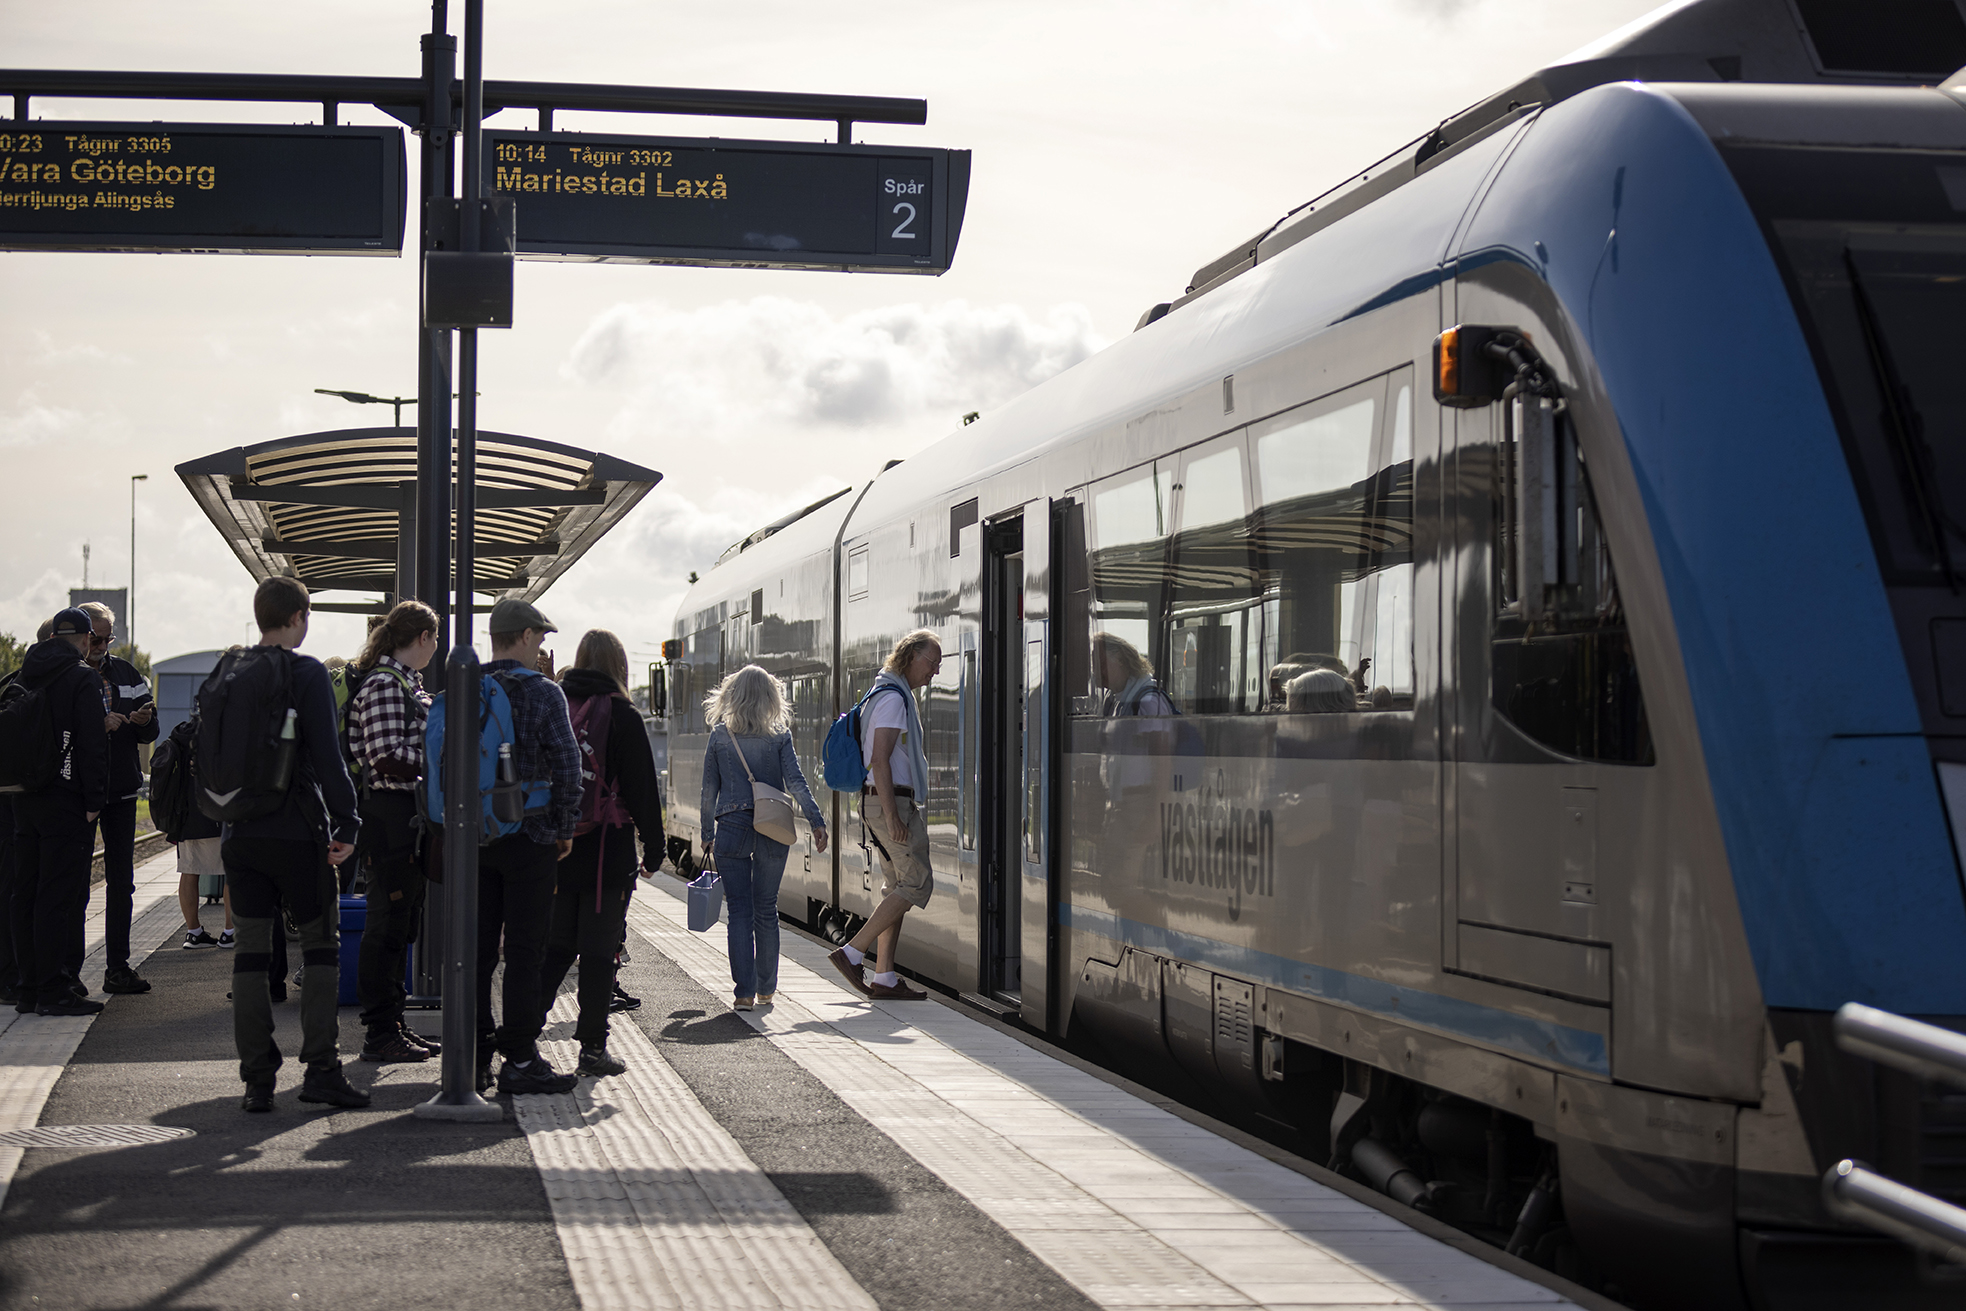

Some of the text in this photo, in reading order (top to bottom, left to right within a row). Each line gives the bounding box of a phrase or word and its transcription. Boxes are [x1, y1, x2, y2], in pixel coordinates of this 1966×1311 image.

[65, 134, 122, 156] Tågnr
[127, 137, 172, 153] 3305
[496, 143, 673, 168] 10:14 Tågnr 3302
[71, 158, 216, 190] Göteborg
[496, 166, 728, 199] Mariestad Laxå
[884, 178, 925, 197] Spår
[0, 190, 175, 212] errljunga Alingsås
[891, 202, 917, 239] 2
